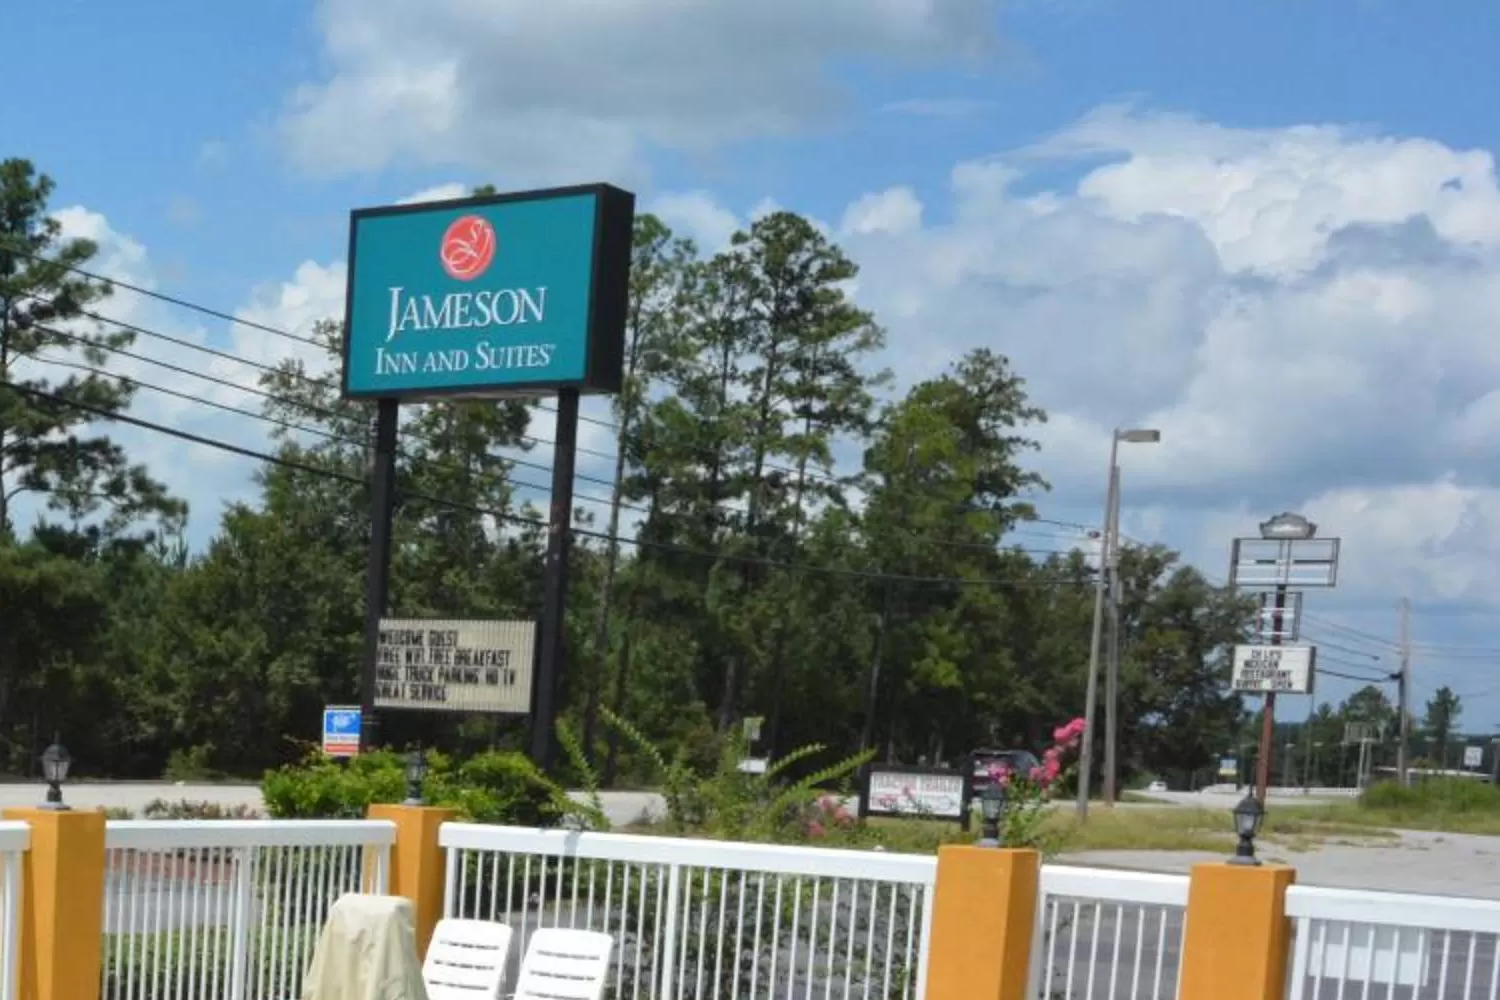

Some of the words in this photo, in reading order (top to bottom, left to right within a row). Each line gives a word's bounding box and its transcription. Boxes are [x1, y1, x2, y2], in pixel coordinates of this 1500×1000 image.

[386, 286, 548, 342] JAMESON
[374, 347, 417, 375] INN
[422, 348, 469, 373] AND
[475, 341, 551, 371] SUITES
[379, 629, 425, 646] WELCOME
[376, 647, 400, 664] FREE
[429, 647, 452, 664] FREE
[454, 649, 511, 667] BREAKFAST
[405, 665, 434, 683] TRUCK
[438, 666, 480, 685] PARKING
[410, 683, 447, 702] SERVICE
